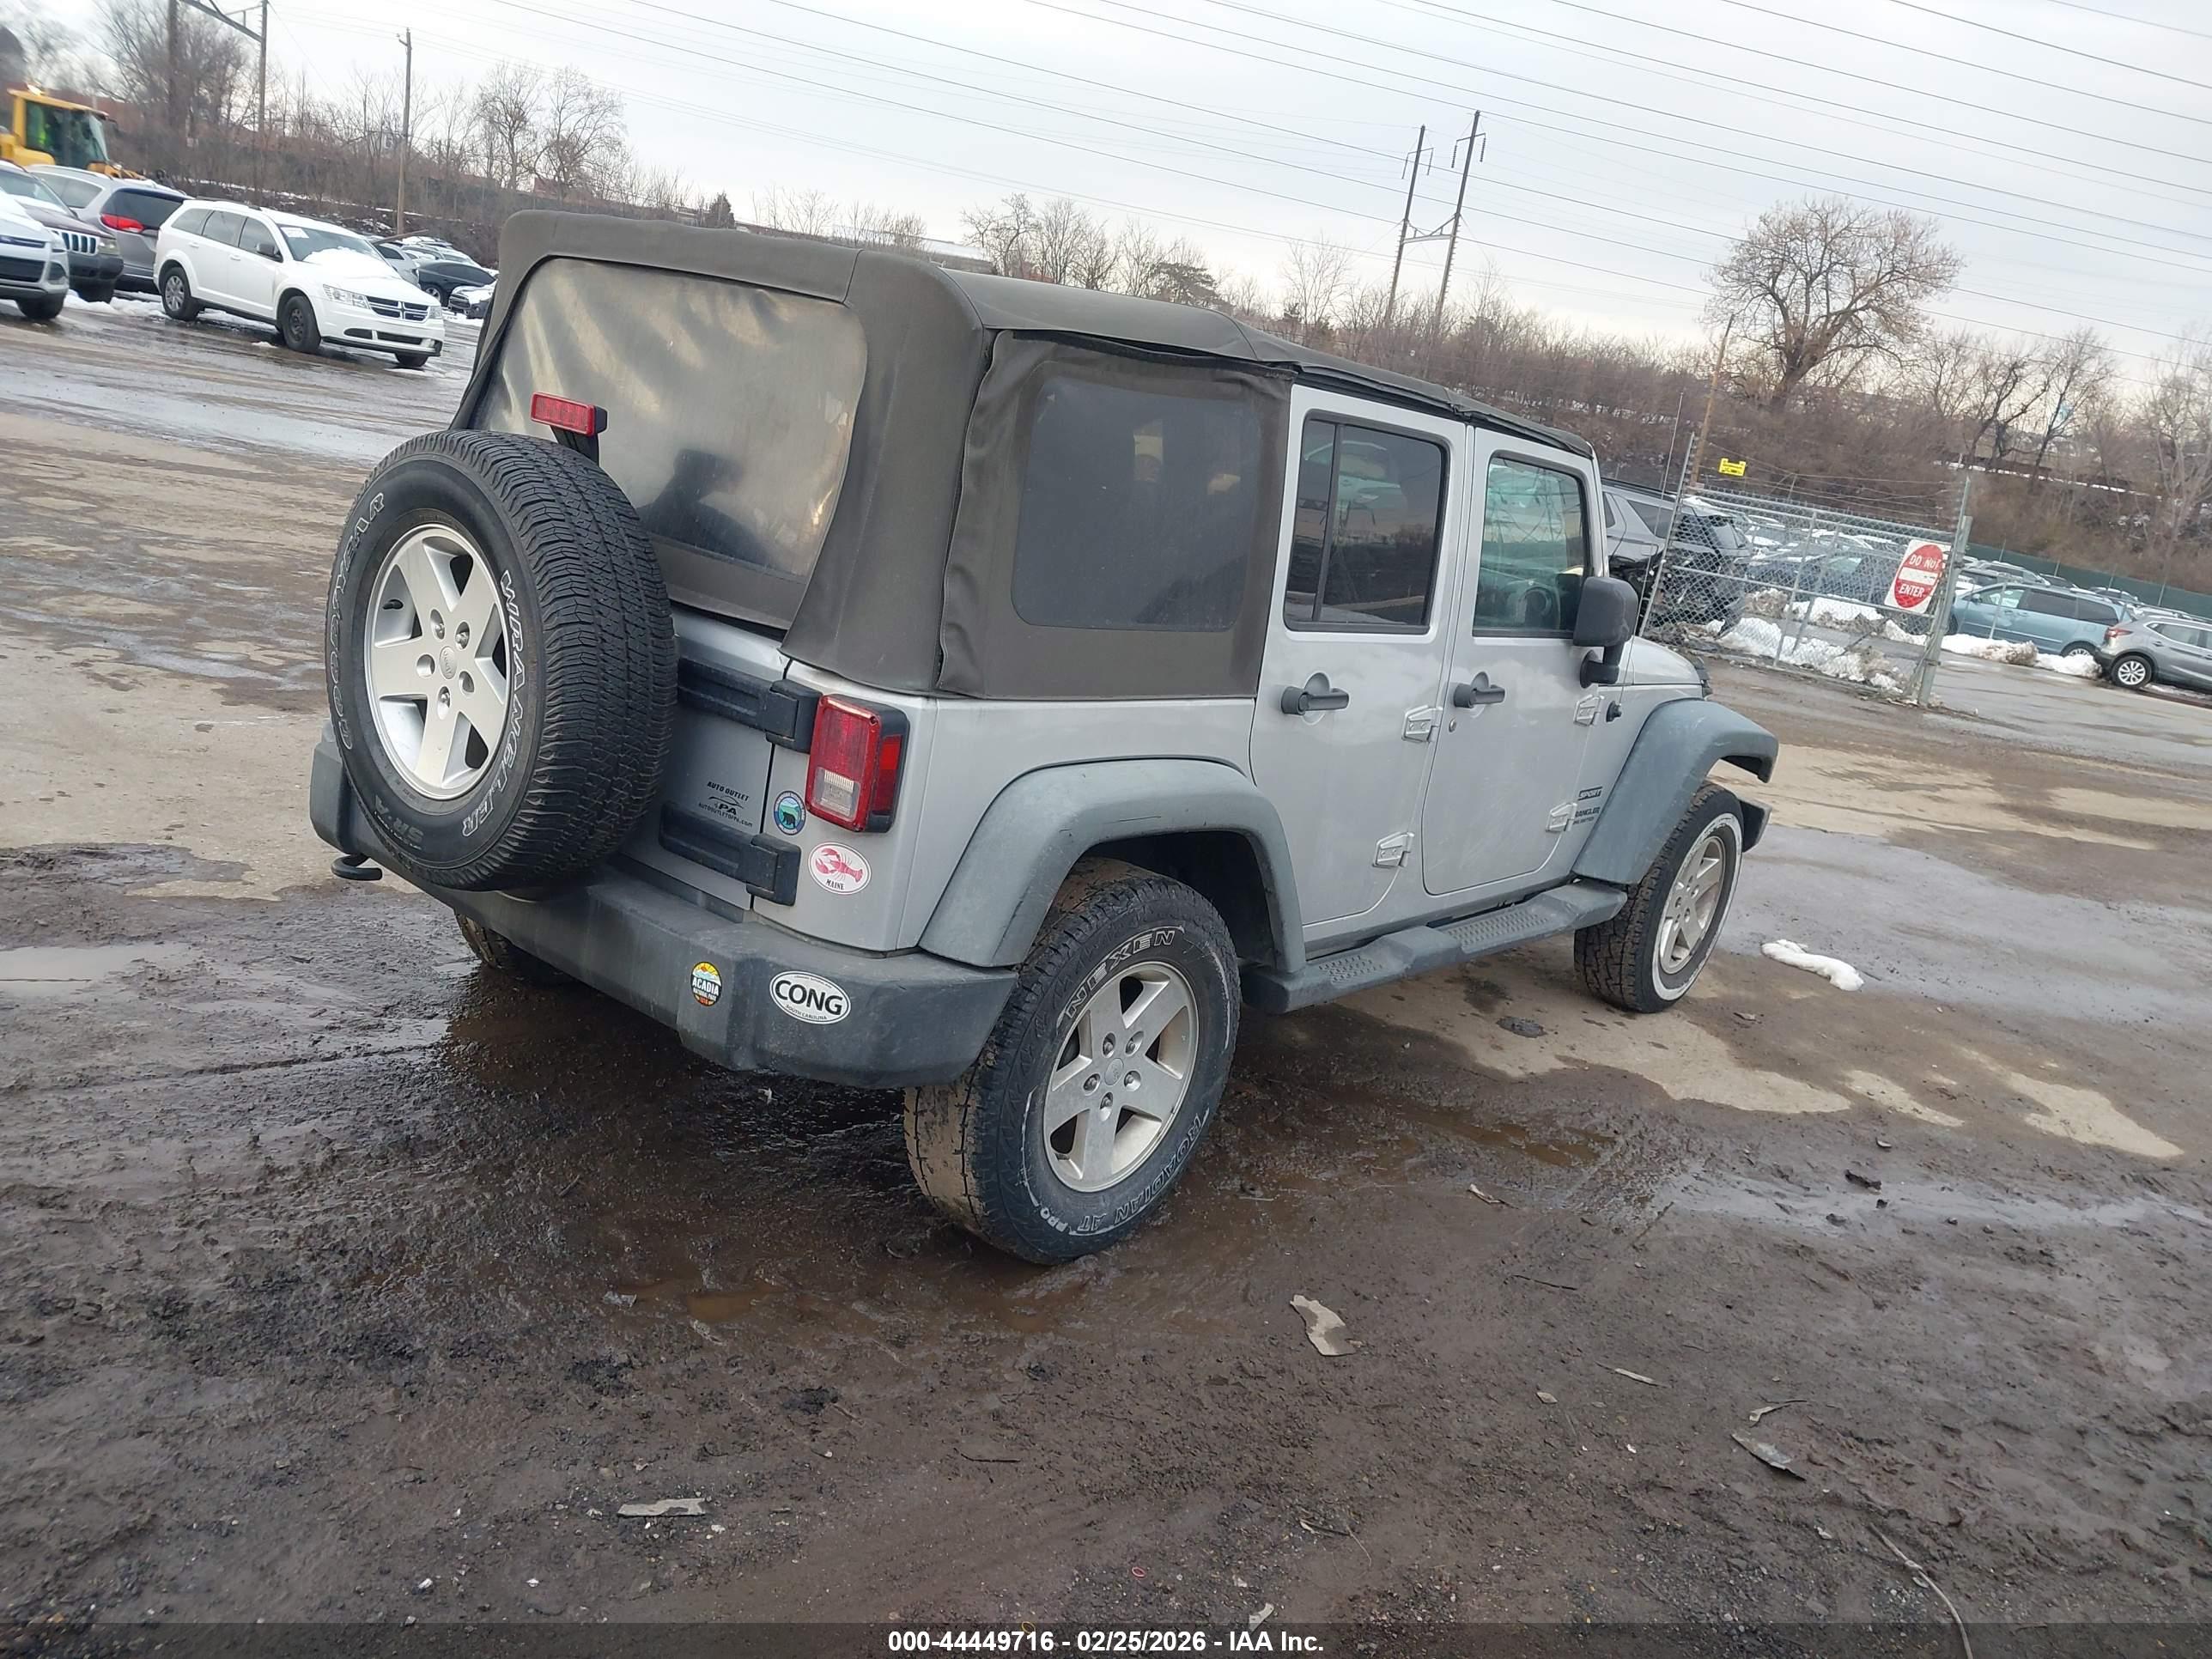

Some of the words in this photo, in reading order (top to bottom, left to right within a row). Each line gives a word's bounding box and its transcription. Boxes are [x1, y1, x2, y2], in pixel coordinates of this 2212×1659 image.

[1909, 553, 1923, 567] DO
[1923, 557, 1942, 570] NOT
[1899, 584, 1925, 599] ENTER
[331, 492, 385, 750] GOODYEAR
[462, 569, 526, 837] WRANGLER
[707, 781, 725, 792] AUTO
[725, 787, 749, 801] OUTLET
[718, 803, 737, 816] PA
[826, 878, 845, 890] MAINE
[1065, 930, 1176, 1018] NEXEN
[692, 976, 720, 997] ACADIA
[775, 979, 843, 1016] CONG
[785, 1004, 801, 1017] SOUTH
[801, 1012, 828, 1021] CAROLINA
[1114, 1113, 1203, 1224] ROADIAN
[1040, 1206, 1069, 1233] PRO
